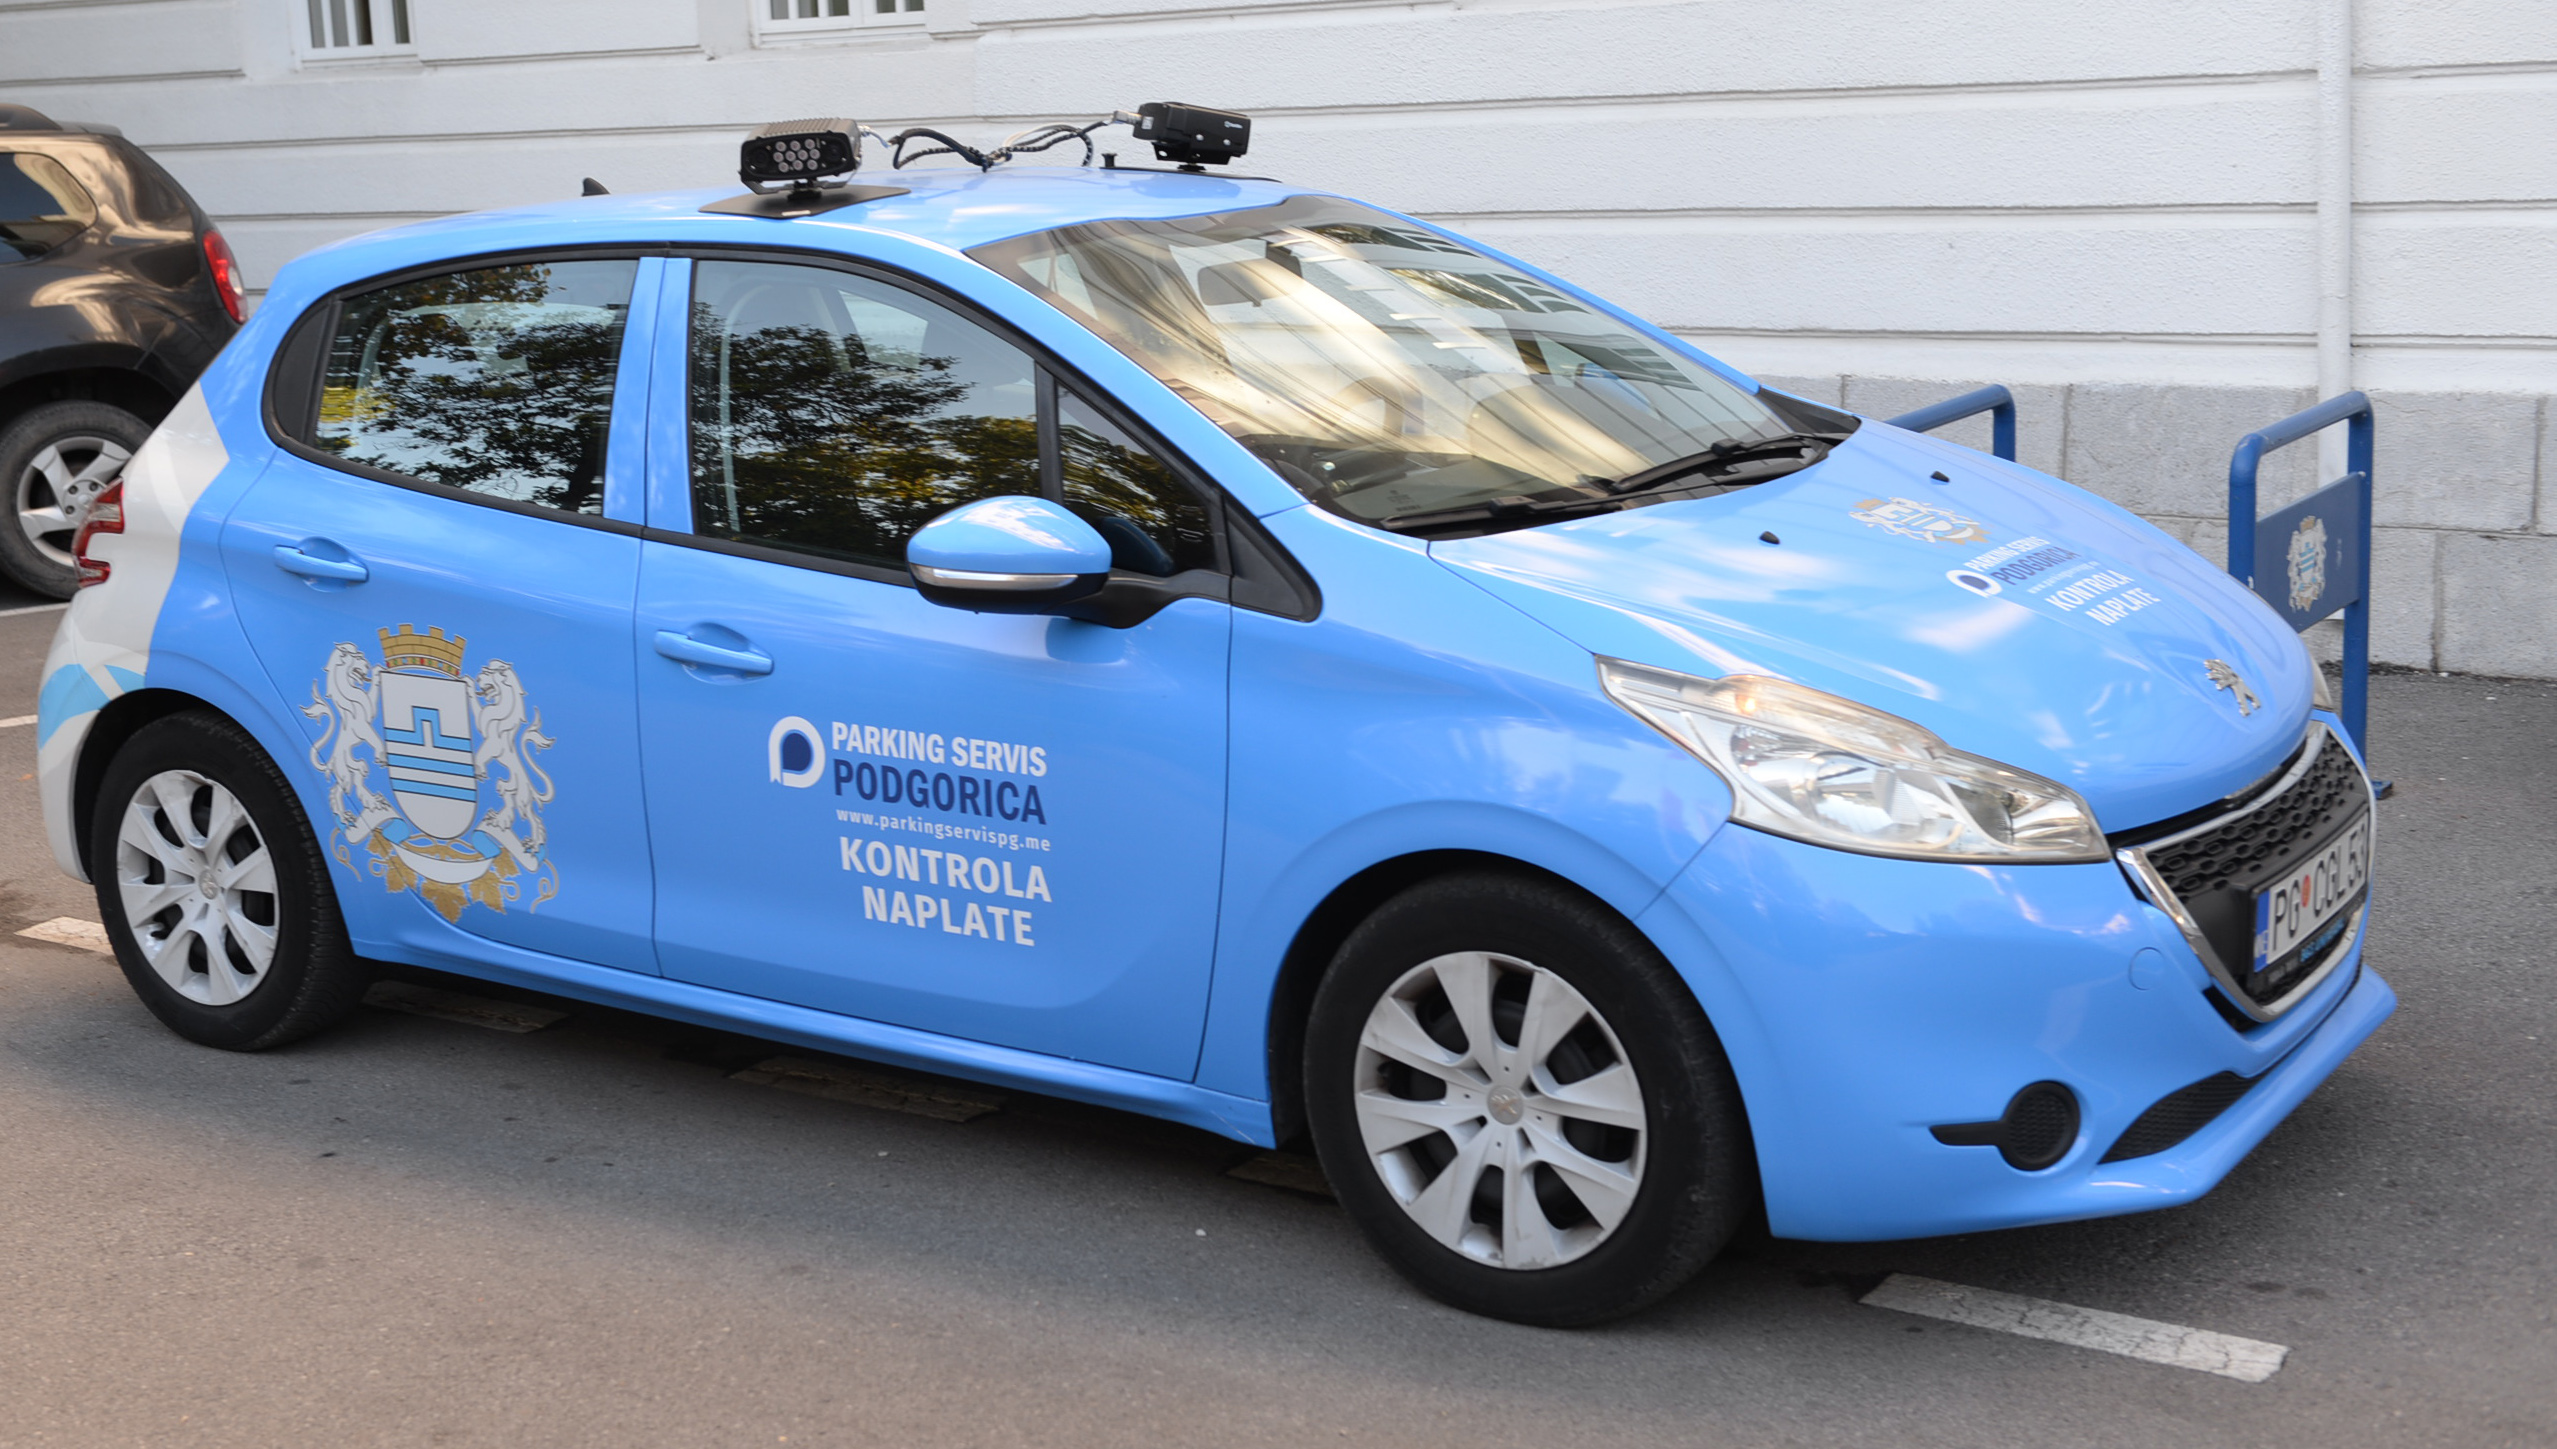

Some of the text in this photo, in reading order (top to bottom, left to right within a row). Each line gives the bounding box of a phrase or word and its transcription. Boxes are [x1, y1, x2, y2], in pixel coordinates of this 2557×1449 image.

[1990, 546, 2081, 585] PODGORICA
[2044, 569, 2135, 611] KONTROLA
[2085, 587, 2162, 626] NAPLATE
[832, 721, 1047, 777] PARKING SERVIS
[833, 758, 1047, 825] PODGORICA
[836, 809, 1051, 851] www.parkingservispg.me
[839, 836, 1052, 902] KONTROLA
[862, 885, 1035, 947] NAPLATE
